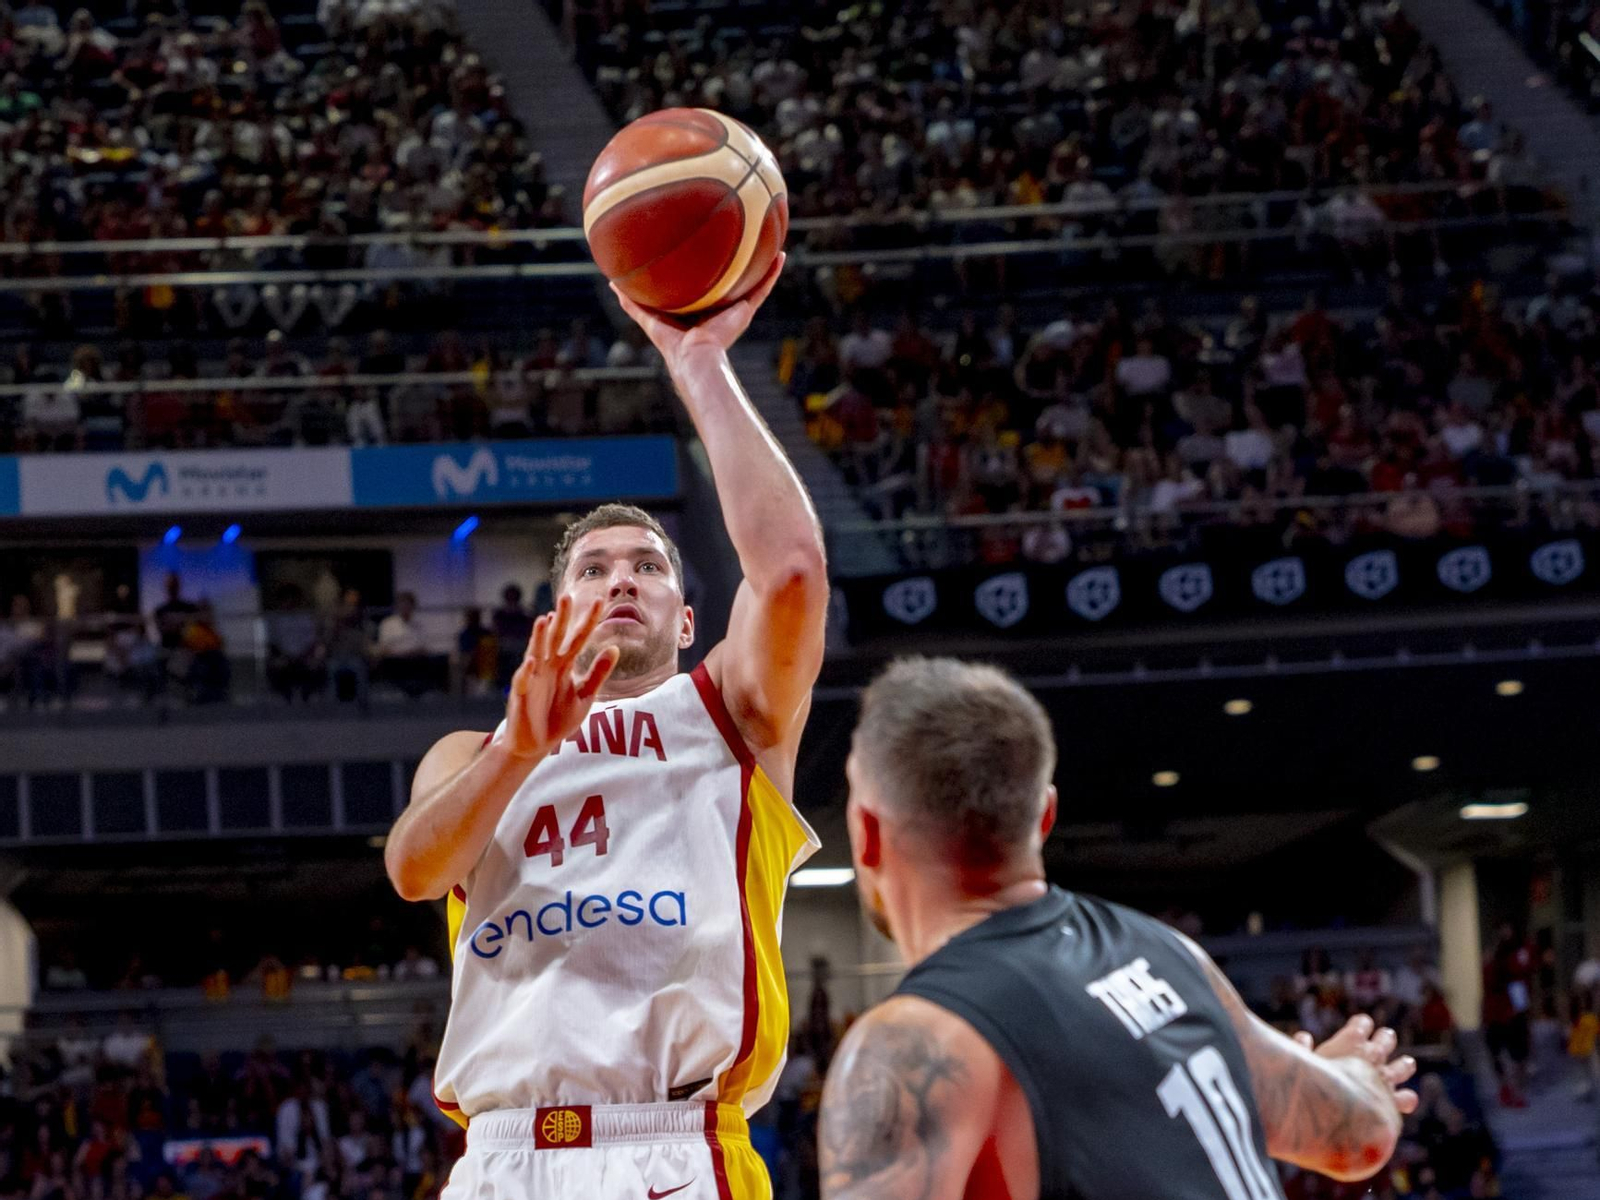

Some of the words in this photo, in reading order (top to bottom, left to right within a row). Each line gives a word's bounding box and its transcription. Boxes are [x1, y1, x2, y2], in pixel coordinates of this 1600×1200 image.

[550, 705, 668, 762] AÑA
[523, 794, 610, 868] 44
[471, 890, 687, 959] endesa
